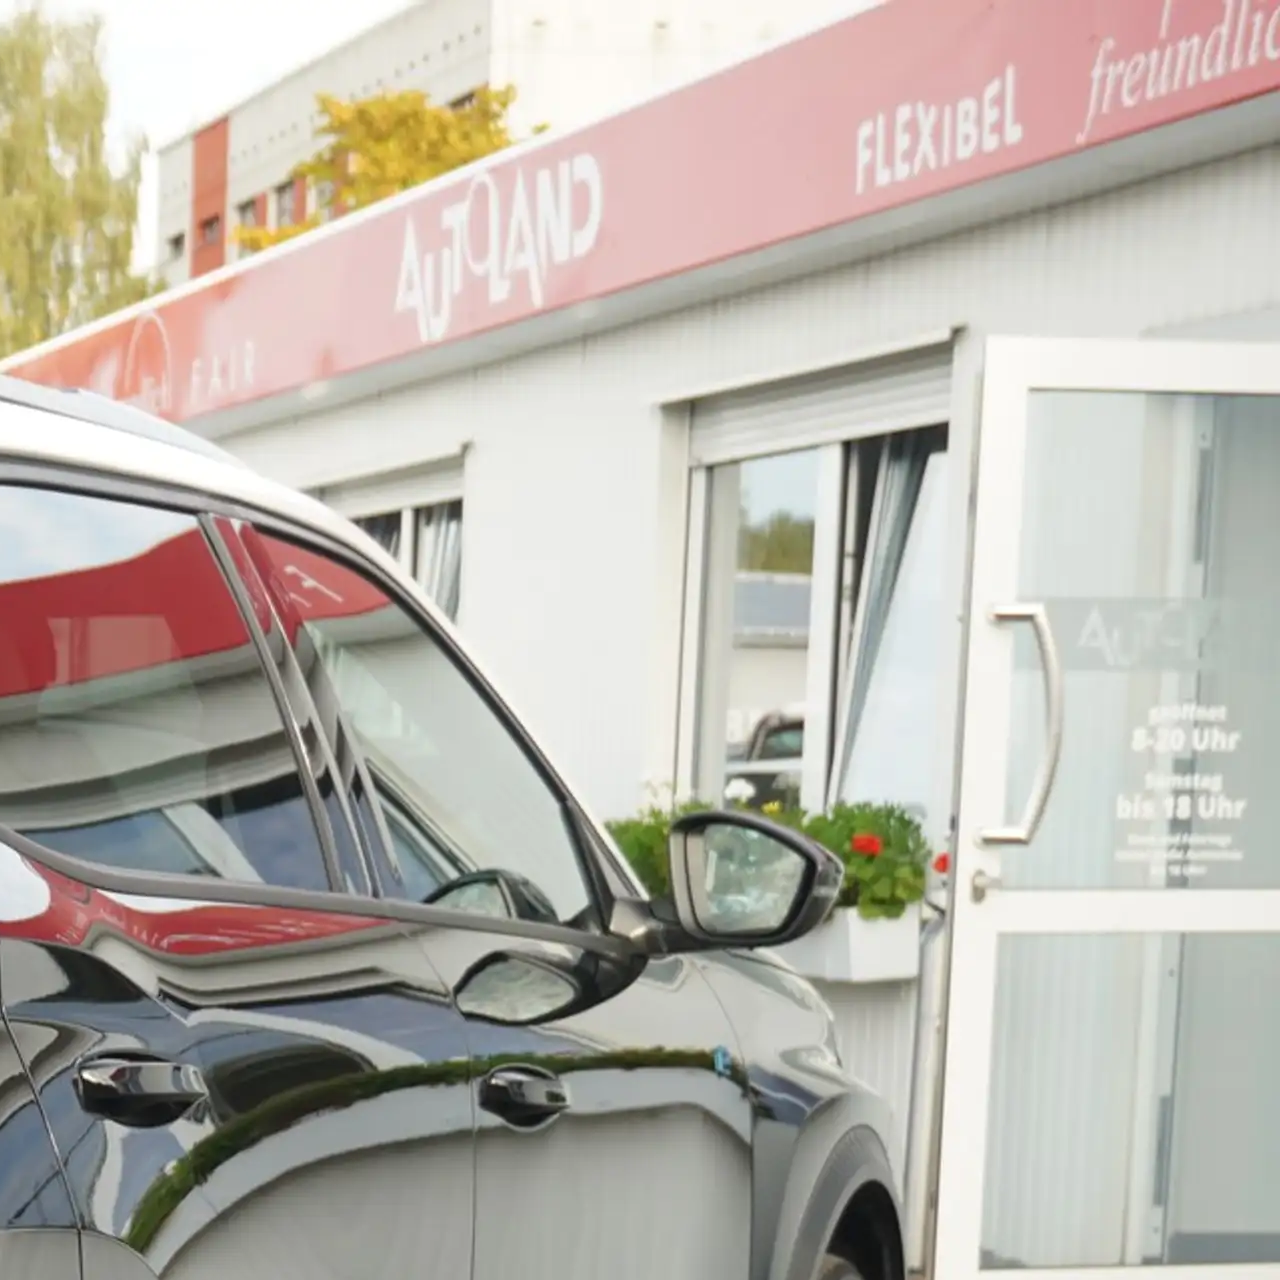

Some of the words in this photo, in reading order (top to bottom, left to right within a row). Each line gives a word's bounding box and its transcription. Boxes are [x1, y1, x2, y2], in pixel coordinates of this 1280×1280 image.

[855, 62, 1024, 194] FLEXIBEL
[394, 152, 603, 344] AUTOLAND
[1192, 724, 1242, 752] Uhr
[1197, 793, 1248, 820] Uhr
